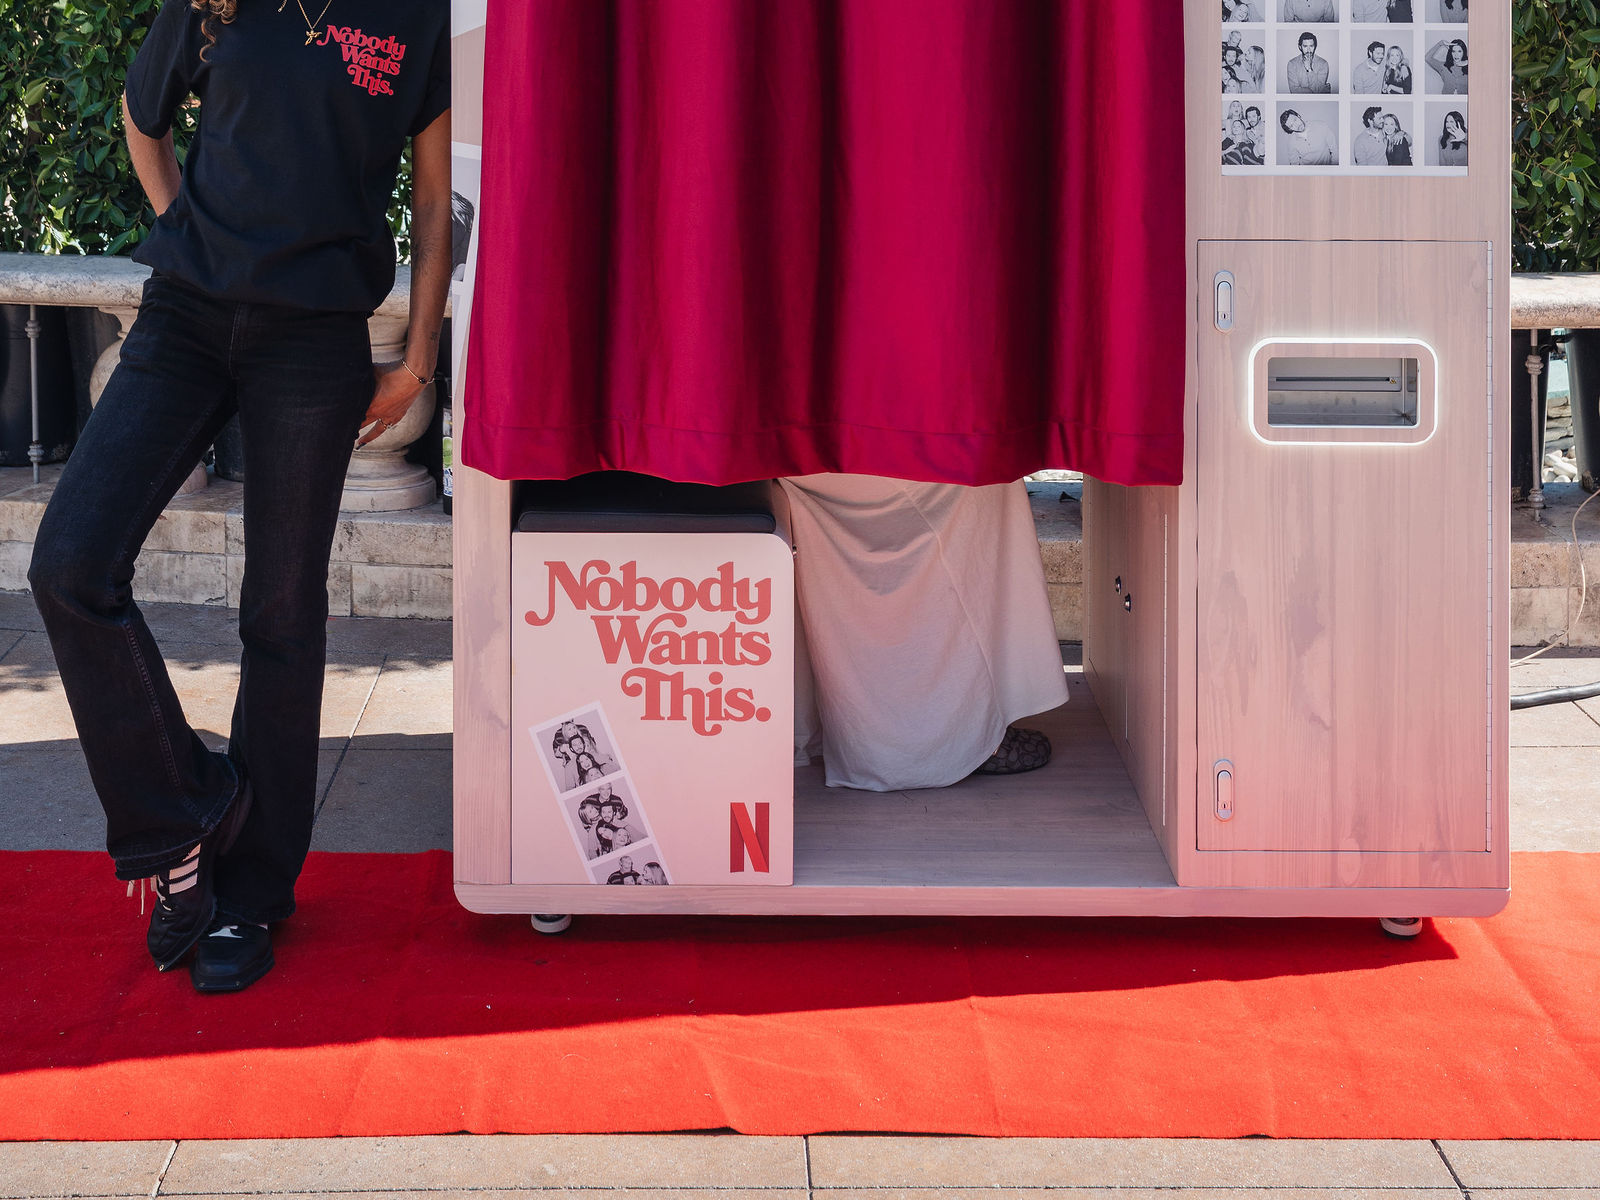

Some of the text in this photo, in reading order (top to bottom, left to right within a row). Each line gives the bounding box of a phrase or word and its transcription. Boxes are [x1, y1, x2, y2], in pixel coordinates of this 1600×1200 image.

[315, 24, 407, 61] Nobody
[340, 43, 401, 75] Wants
[347, 64, 394, 96] This.
[524, 559, 772, 627] Nobody
[589, 612, 773, 667] Wants
[620, 667, 772, 737] This.
[729, 801, 771, 874] N
